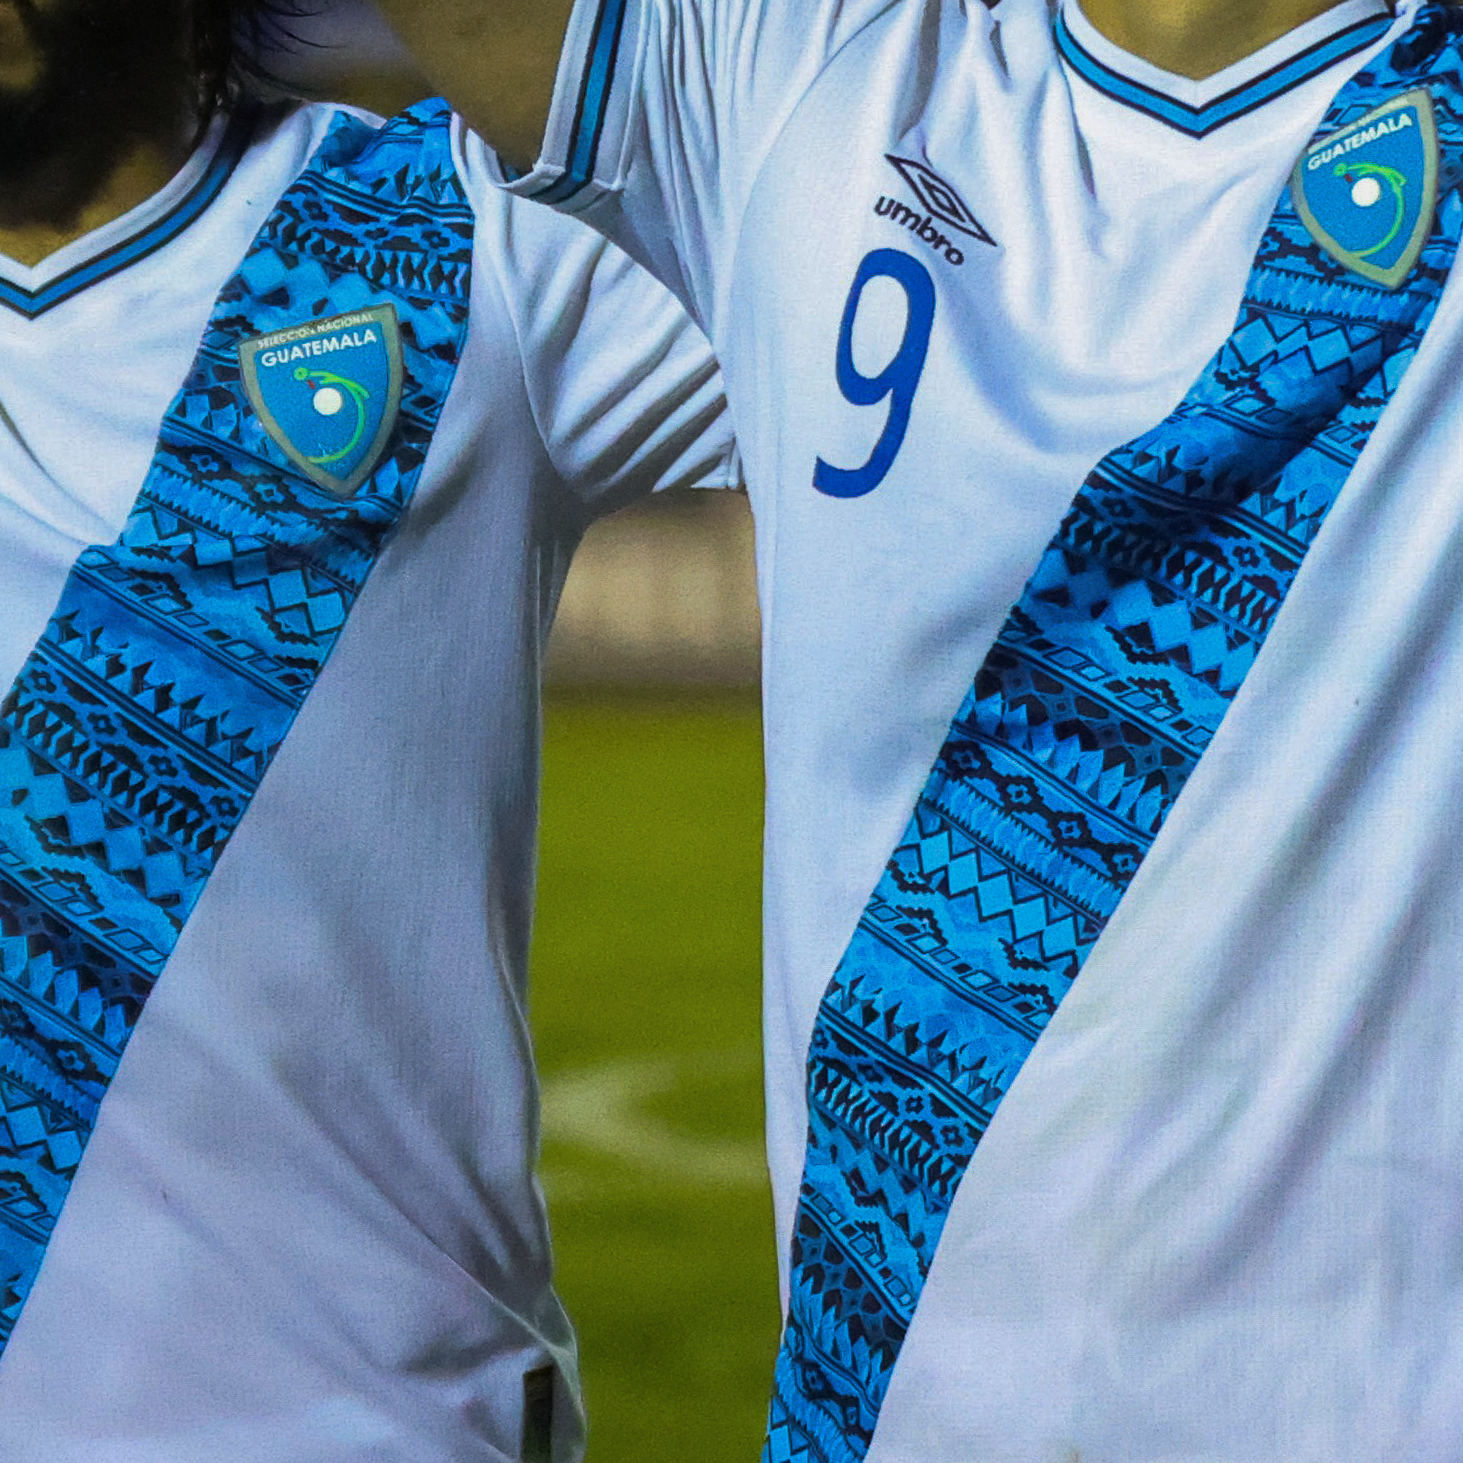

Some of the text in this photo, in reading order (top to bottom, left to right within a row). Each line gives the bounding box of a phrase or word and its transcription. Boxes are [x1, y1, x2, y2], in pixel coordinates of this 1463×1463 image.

[1307, 113, 1413, 171] GUATEMALA
[873, 195, 965, 266] umbro
[261, 328, 378, 368] GUATEMALA
[811, 247, 936, 499] 9
